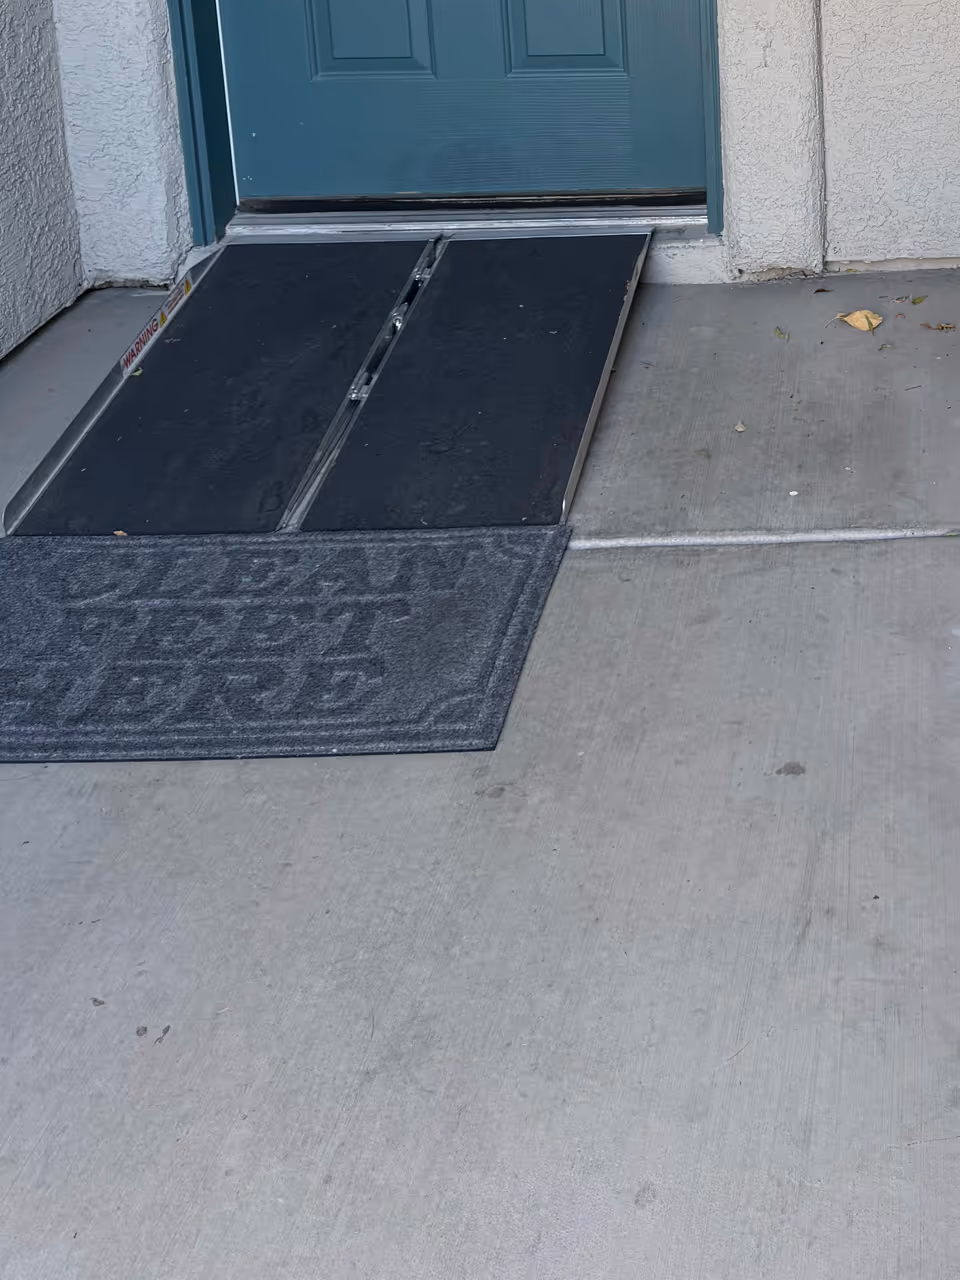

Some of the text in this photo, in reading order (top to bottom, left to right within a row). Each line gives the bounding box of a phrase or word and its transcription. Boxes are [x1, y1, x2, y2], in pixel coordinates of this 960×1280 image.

[123, 318, 159, 368] WARNING
[56, 546, 480, 600] CLEAN
[60, 601, 411, 658] FEET
